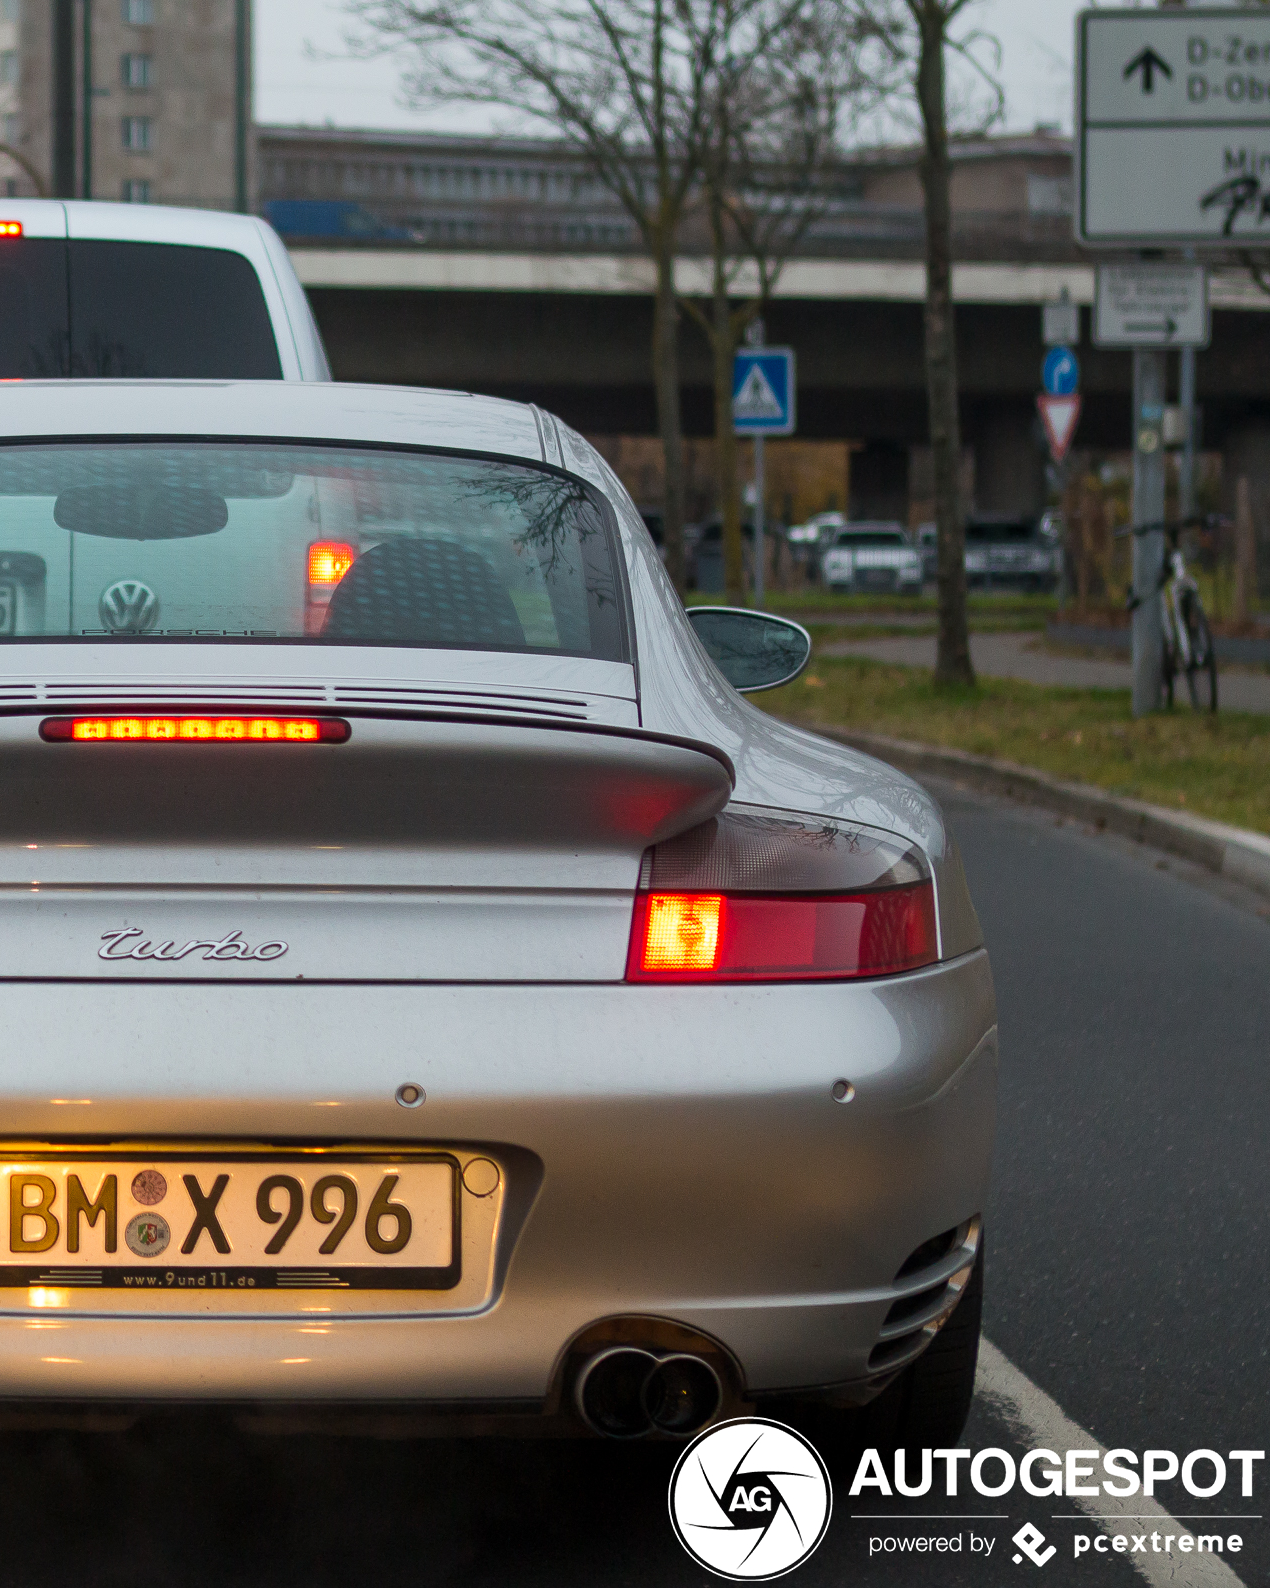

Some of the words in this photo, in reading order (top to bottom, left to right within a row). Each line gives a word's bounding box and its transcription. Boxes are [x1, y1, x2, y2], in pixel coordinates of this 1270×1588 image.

[1188, 73, 1270, 102] D-Ob
[98, 927, 289, 961] turbo
[9, 1174, 117, 1254] BM
[181, 1174, 231, 1255] X
[256, 1174, 413, 1255] 996
[123, 1272, 255, 1287] www.9und11.de
